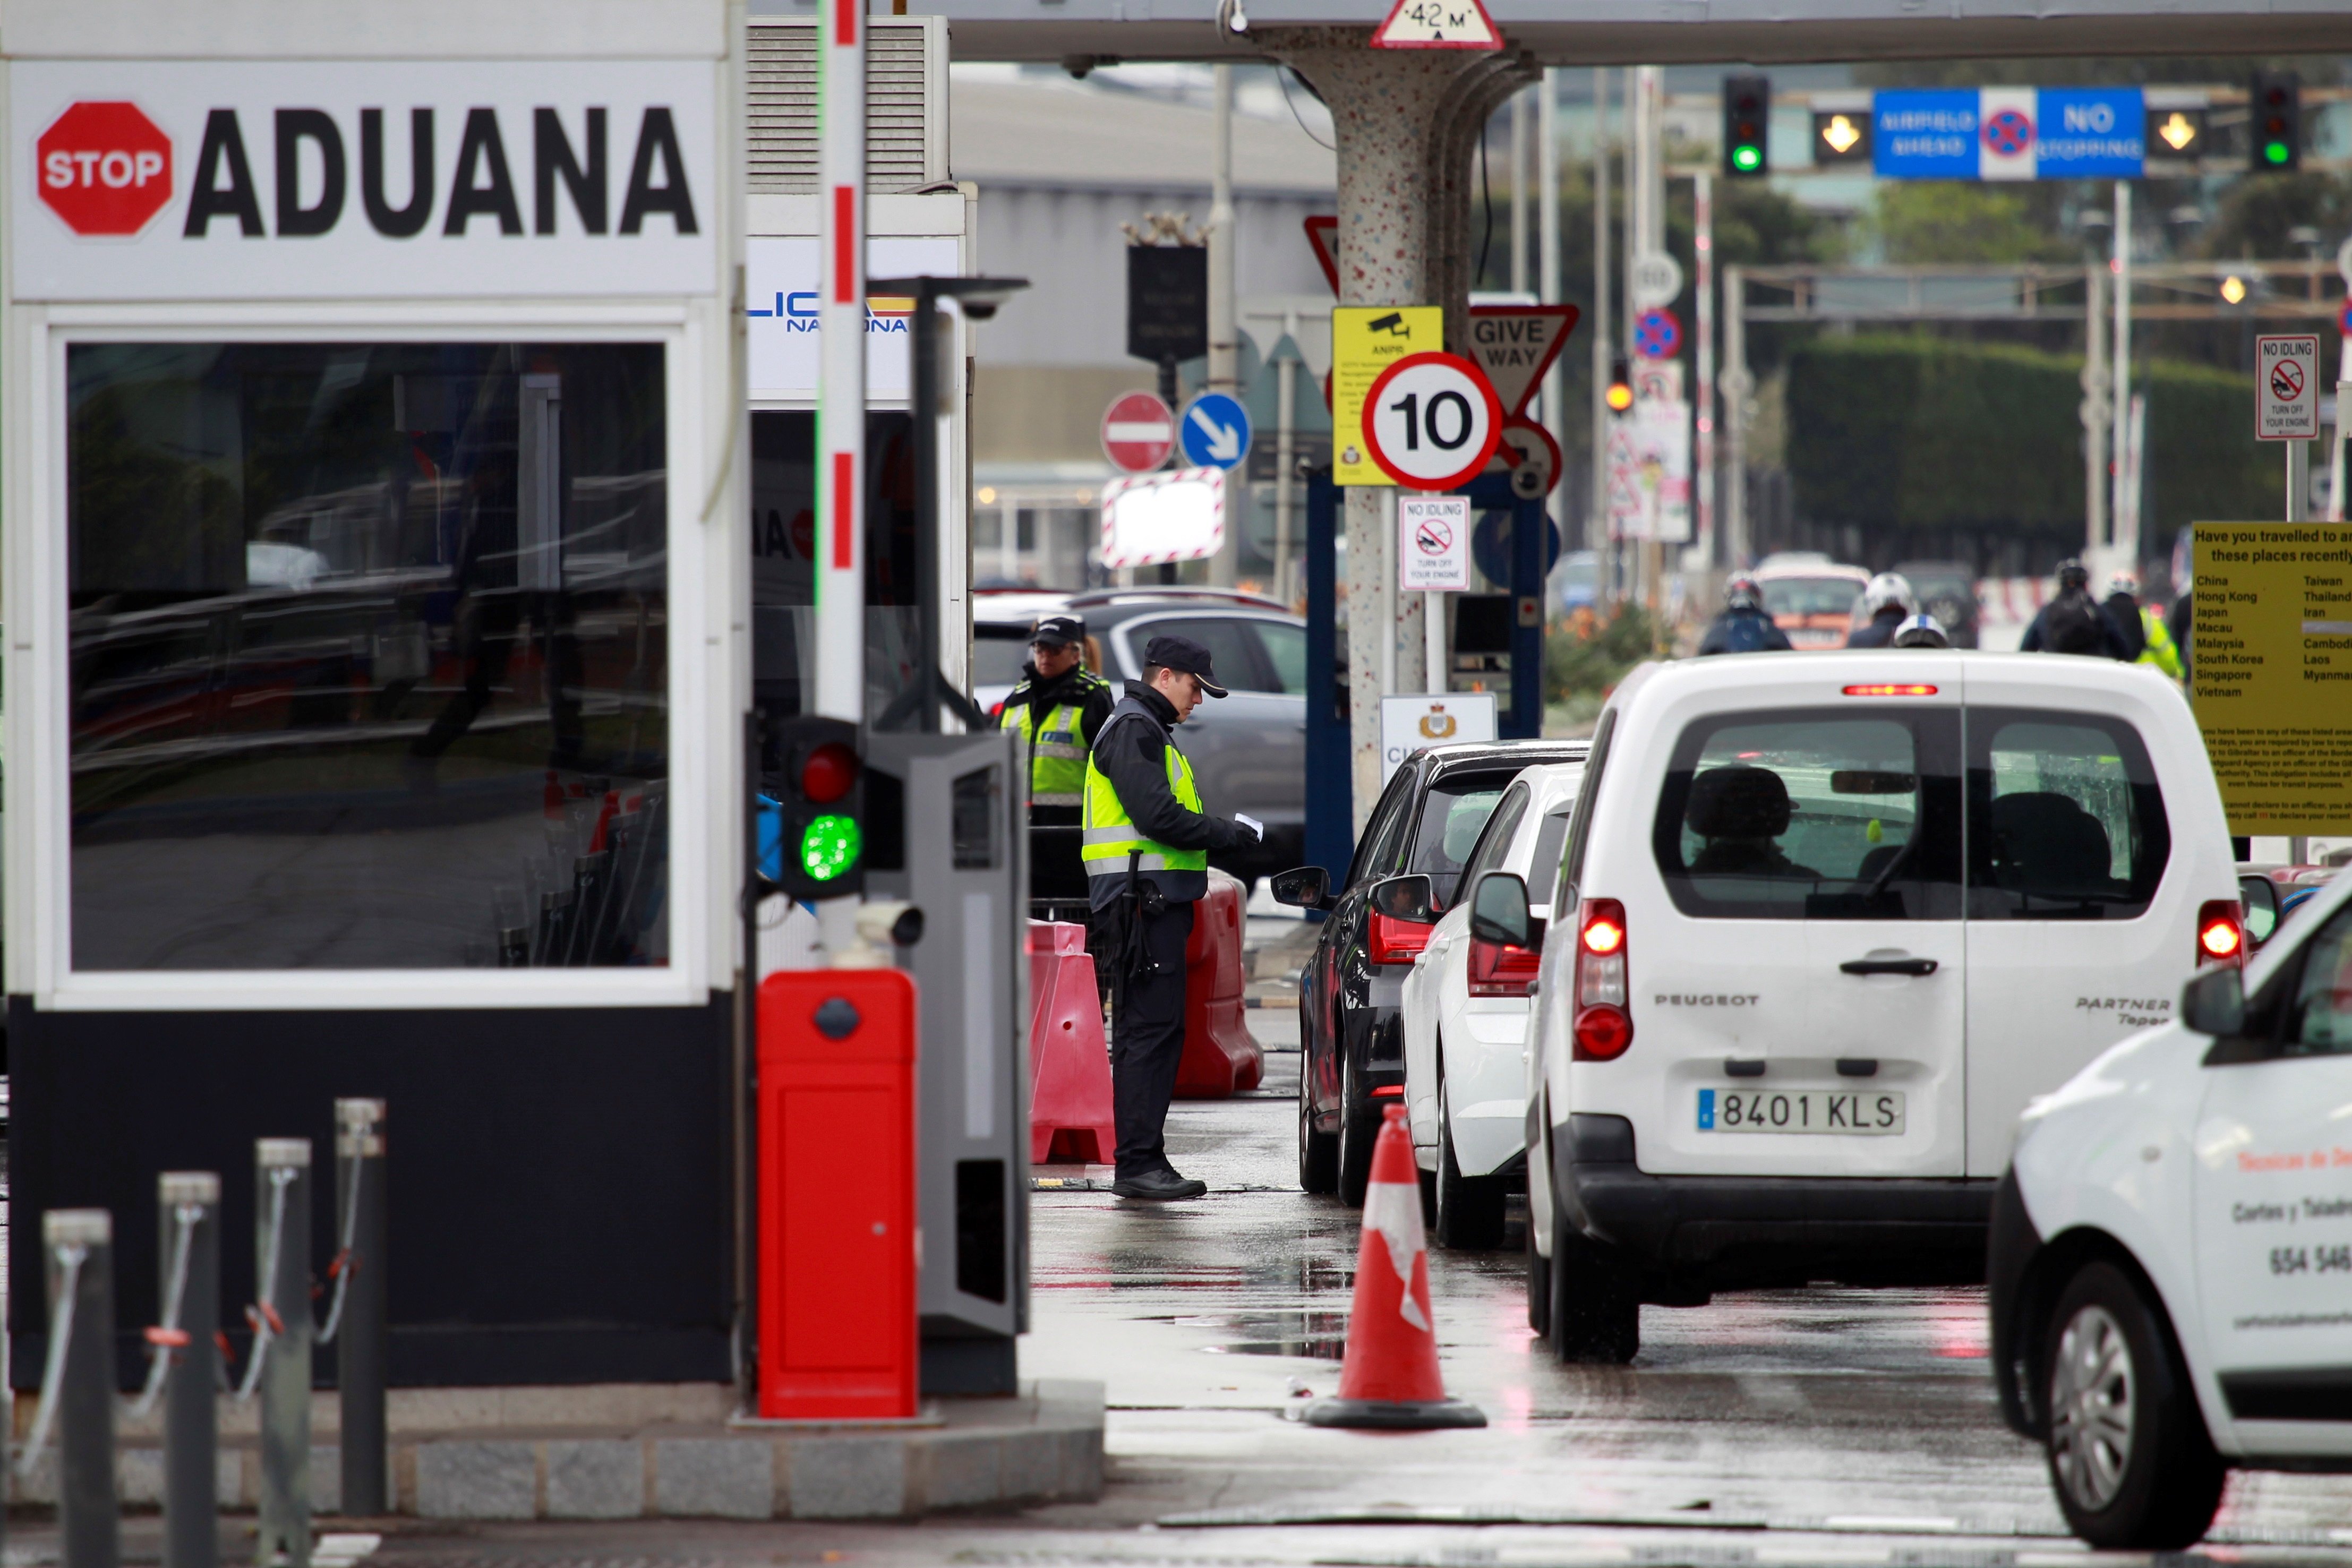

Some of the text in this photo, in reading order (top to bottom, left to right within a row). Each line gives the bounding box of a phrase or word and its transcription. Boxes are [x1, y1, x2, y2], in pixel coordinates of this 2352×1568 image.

[1880, 110, 1977, 132] AIRFIELD
[2064, 103, 2115, 133] NO
[1892, 136, 1965, 157] AHEAD
[2037, 138, 2143, 160] STOPPING
[45, 150, 163, 188] STOP
[183, 107, 699, 239] ADUANA
[1475, 319, 1544, 344] GIVE
[1372, 346, 1404, 355] ANPR
[2263, 342, 2312, 355] NO IDLING
[1486, 349, 1537, 367] WAY
[2272, 405, 2304, 414] TURN OFF
[1390, 391, 1473, 451] 10
[2266, 418, 2310, 427] YOUR ENGINE
[1408, 503, 1461, 515] NO IDLING
[2195, 530, 2228, 542] Have
[2232, 532, 2256, 545] you
[2260, 530, 2319, 542] travelled
[2323, 531, 2337, 542] to
[2212, 549, 2248, 561] these
[2253, 549, 2296, 564] places
[1410, 570, 1459, 578] YOUR ENGINE
[2196, 576, 2228, 586] China
[2304, 576, 2342, 586] Taiwan
[2196, 592, 2257, 604] Hong Kong
[2304, 591, 2352, 602] Thailand
[2196, 608, 2228, 619] Japan
[2304, 608, 2325, 618] Iran
[2196, 623, 2233, 633] Macau
[2196, 638, 2244, 650] Malaysia
[2196, 654, 2263, 664] South Korea
[2304, 654, 2330, 664] Laos
[2196, 670, 2252, 682] Singapore
[2196, 686, 2242, 697] Vietnam
[1655, 994, 1759, 1006] PEUGEOT
[2076, 997, 2171, 1010] PARTNER
[1723, 1095, 1895, 1127] 8401 KLS
